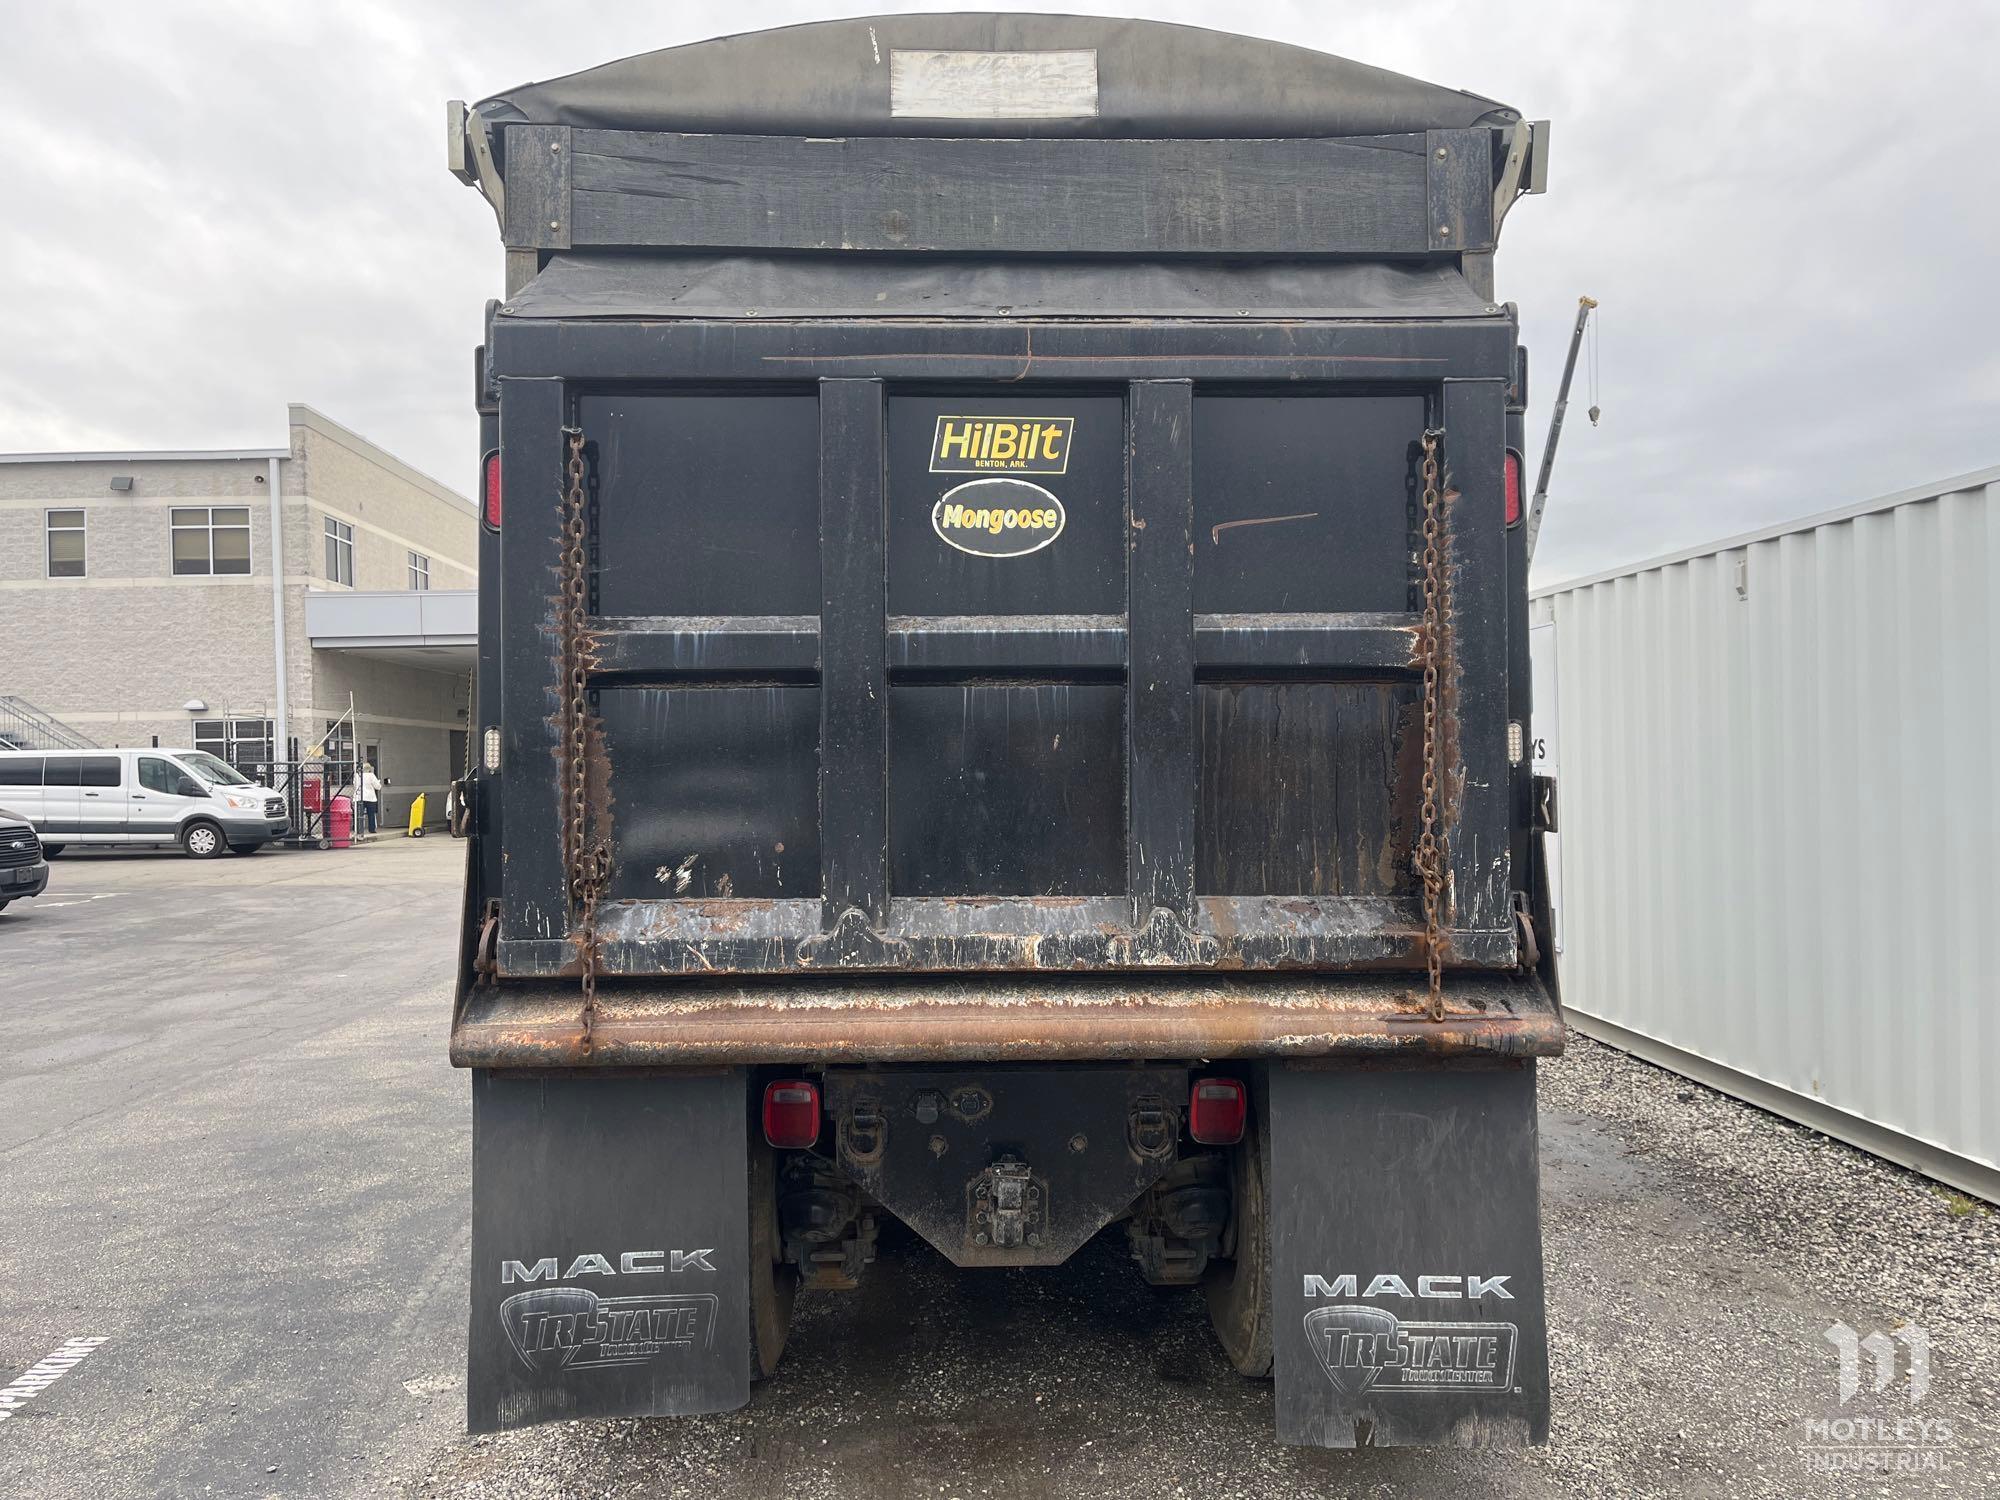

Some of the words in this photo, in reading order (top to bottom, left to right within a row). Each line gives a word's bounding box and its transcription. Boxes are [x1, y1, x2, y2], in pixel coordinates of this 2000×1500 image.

[940, 422, 1063, 460] HilBilt
[975, 460, 1007, 469] BENTON,
[1010, 460, 1028, 468] ARK.
[942, 504, 1057, 534] Mongoose
[502, 1248, 717, 1284] MACK
[1304, 1274, 1515, 1299] MACK
